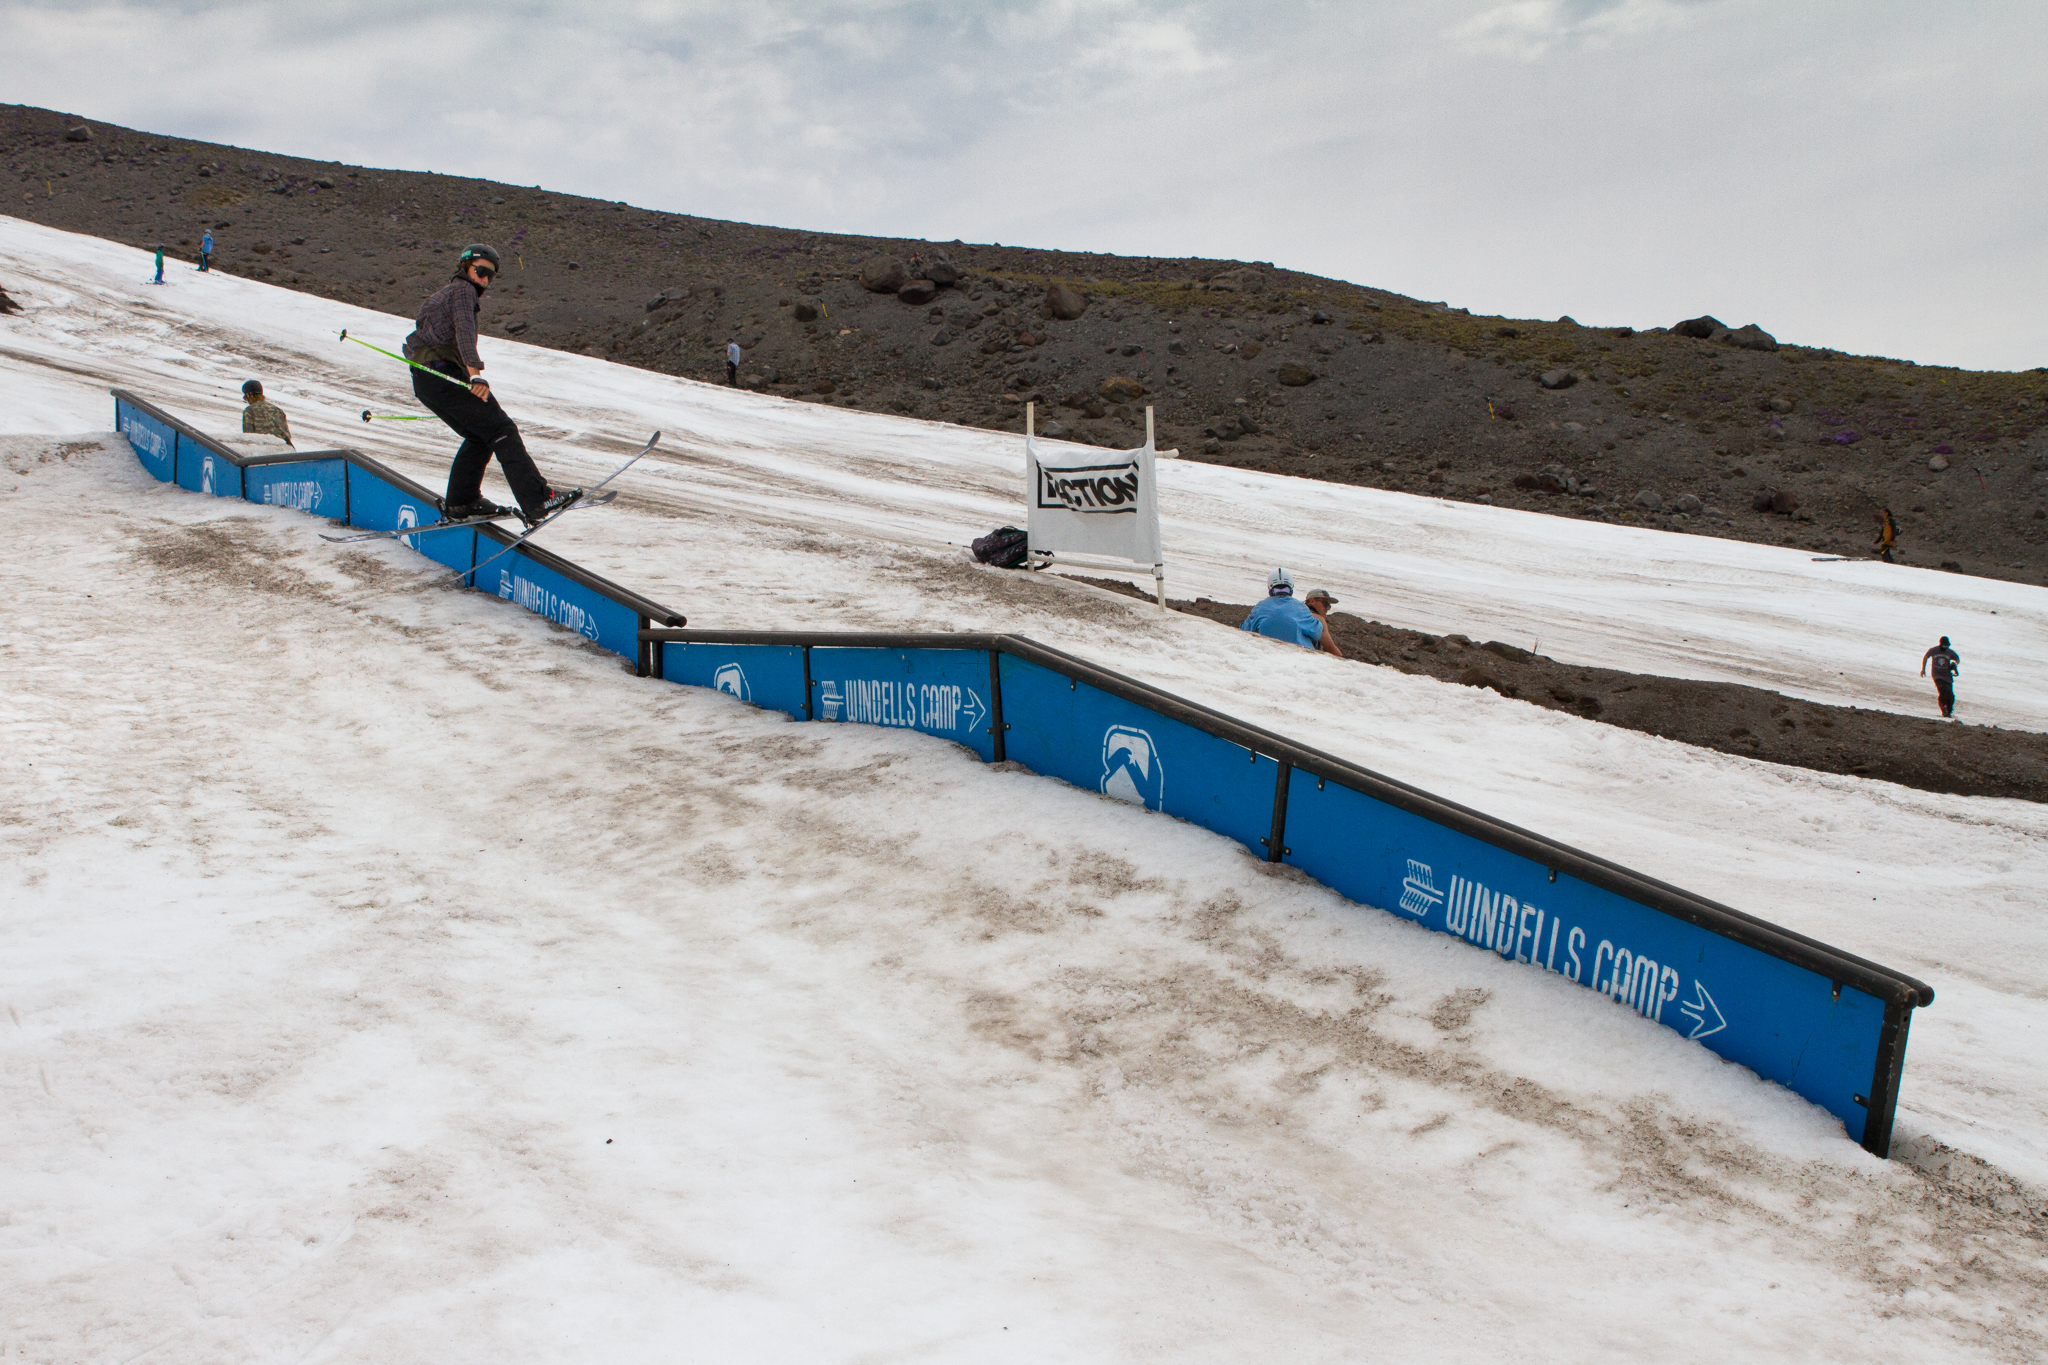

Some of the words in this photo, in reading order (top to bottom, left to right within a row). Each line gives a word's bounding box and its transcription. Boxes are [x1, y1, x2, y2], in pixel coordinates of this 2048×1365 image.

[559, 599, 585, 632] CAMP
[845, 679, 916, 727] WINDELLS
[920, 684, 962, 731] CAMP
[1446, 874, 1586, 984] WINDELLS
[1592, 939, 1679, 1023] CAMP
